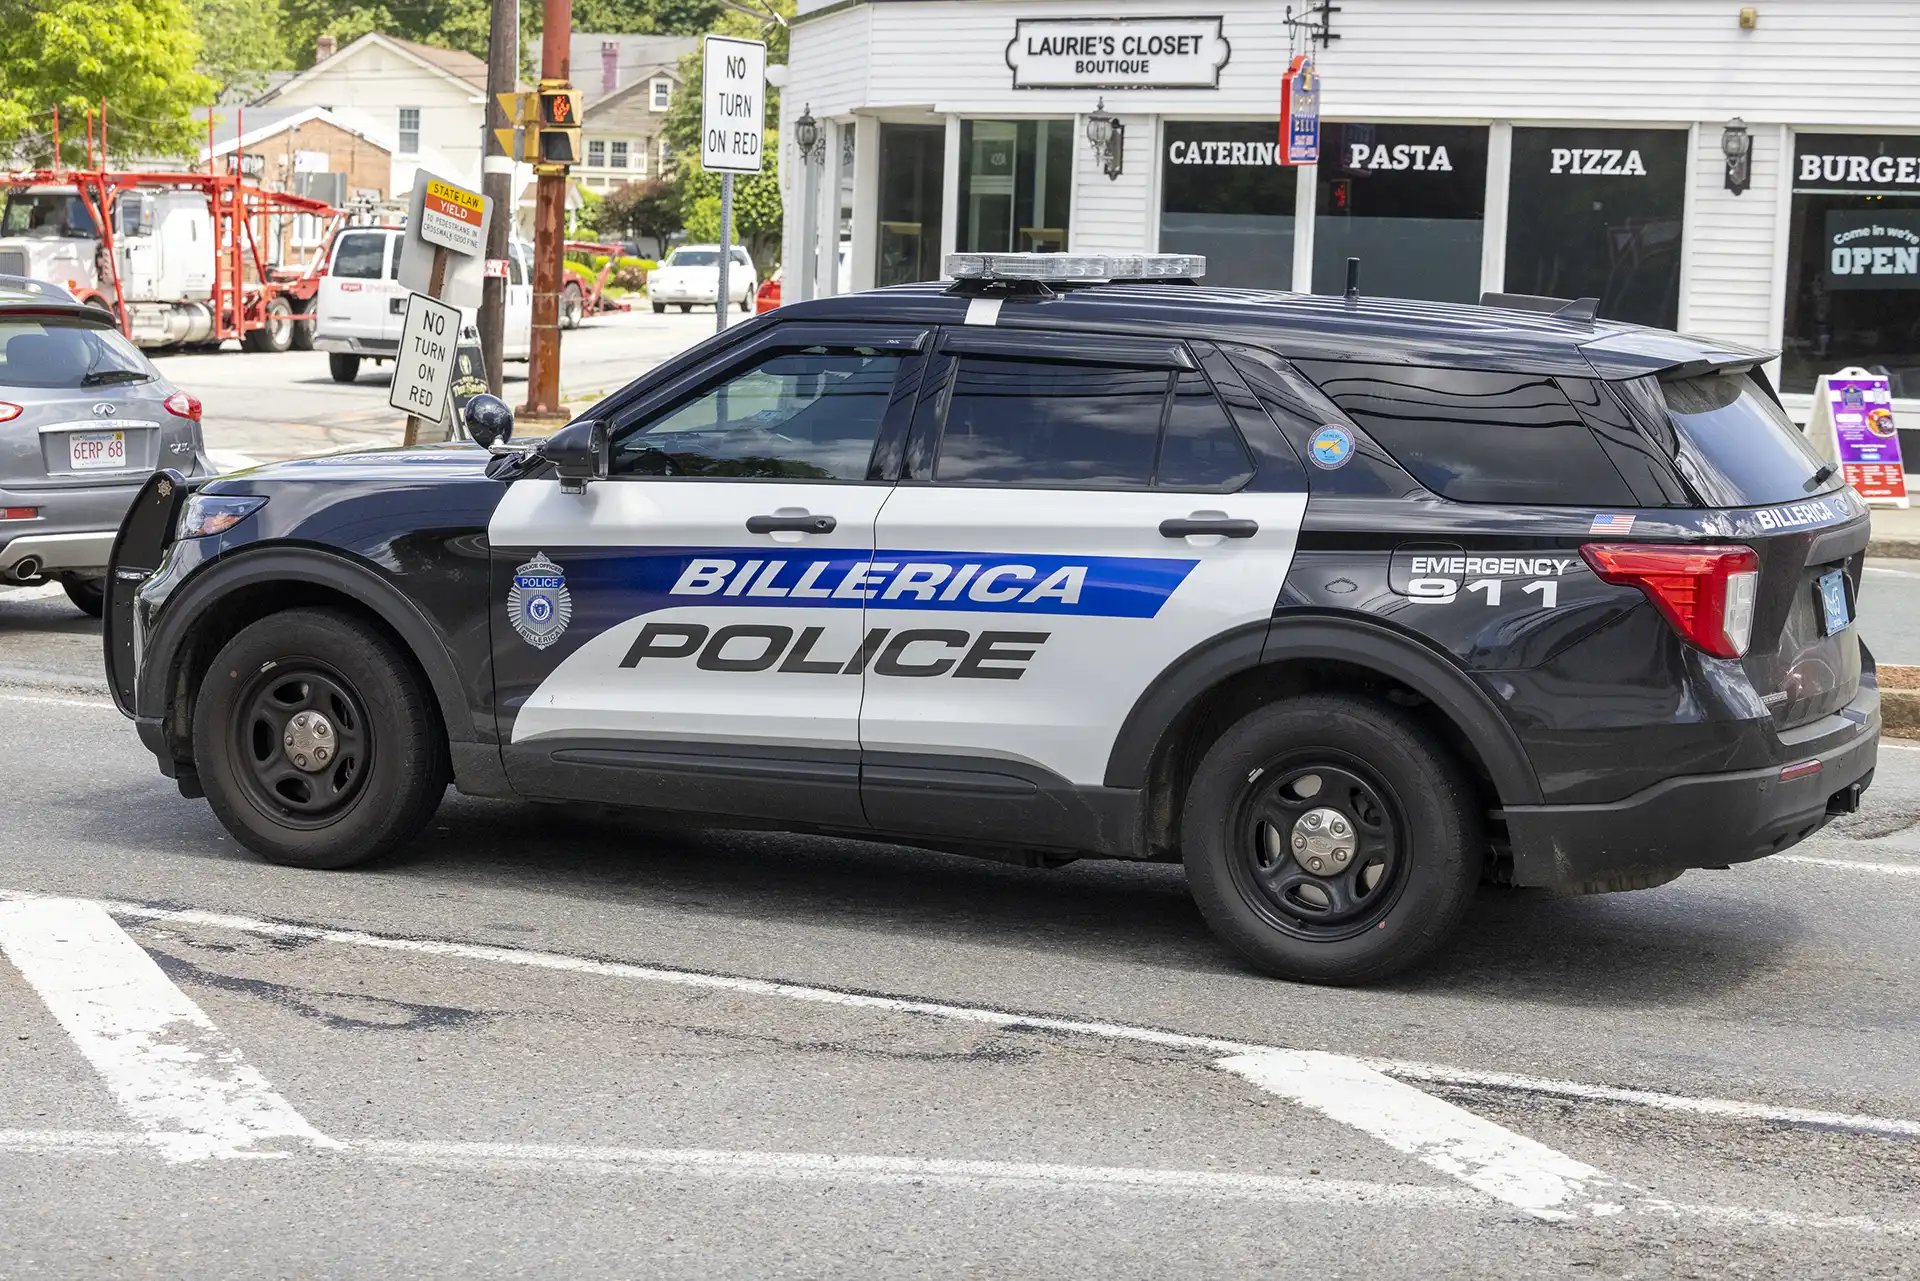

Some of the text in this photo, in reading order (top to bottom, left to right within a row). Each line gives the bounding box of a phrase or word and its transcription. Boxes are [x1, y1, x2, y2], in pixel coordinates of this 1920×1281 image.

[1027, 35, 1203, 56] LAURIE'S CLOSET
[726, 55, 746, 79] NO
[1075, 60, 1150, 74] BOUTIQUE
[719, 92, 751, 118] TURN
[708, 129, 758, 155] ON RED
[1349, 144, 1453, 171] PASTA
[1550, 148, 1647, 175] PIZZA
[1799, 155, 1920, 183] BURGE
[434, 184, 480, 208] STATE LAW
[440, 200, 468, 219] YIELD
[1833, 225, 1920, 245] Come in we're
[1831, 247, 1920, 275] OPEN
[423, 310, 445, 335] NO
[415, 336, 445, 362] TURN
[418, 363, 435, 383] ON
[409, 385, 433, 407] RED
[73, 441, 123, 460] 6ERP 68
[1754, 501, 1835, 530] BILLERICA
[518, 563, 539, 573] POLICE
[1411, 557, 1570, 576] EMERGENCY
[522, 578, 558, 588] POLICE
[669, 558, 1088, 604] BILLERICA
[1407, 578, 1558, 608] 911
[521, 629, 560, 643] BILLERICA
[618, 622, 1052, 680] POLICE
